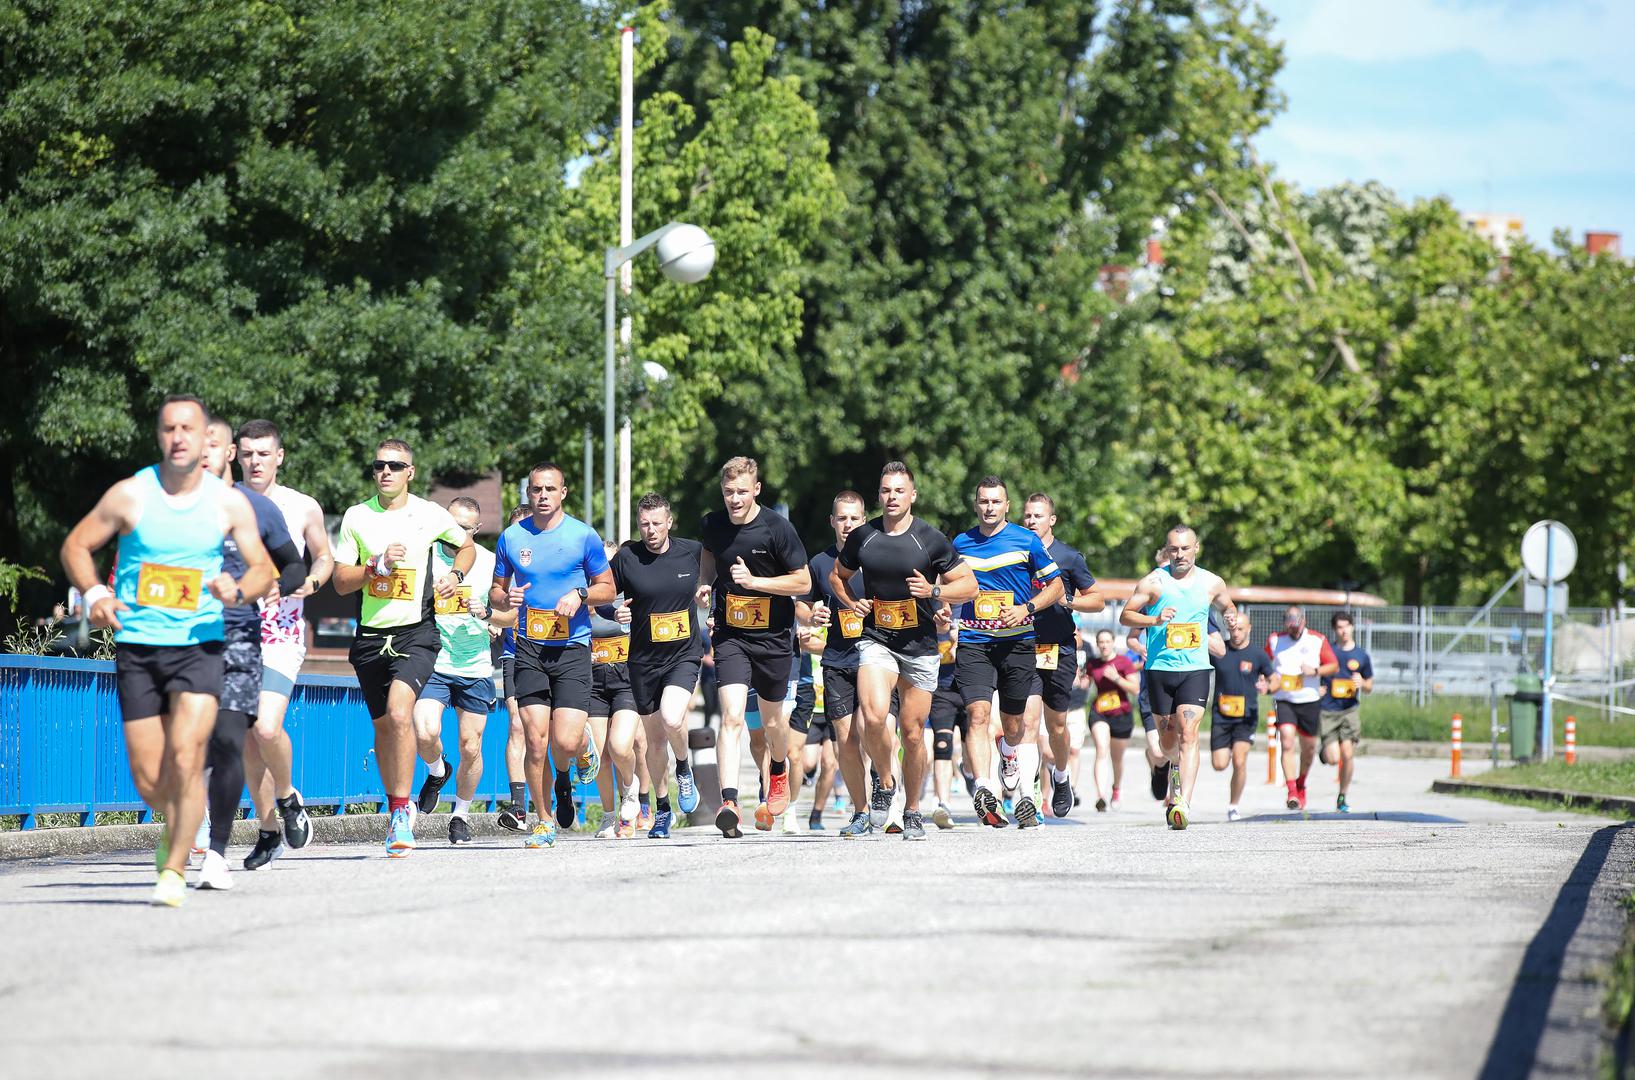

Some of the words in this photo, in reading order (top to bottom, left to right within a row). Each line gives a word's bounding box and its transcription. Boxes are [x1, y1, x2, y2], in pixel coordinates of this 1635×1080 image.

[149, 583, 164, 597] 71
[376, 582, 389, 592] 25
[436, 599, 447, 608] 37
[733, 611, 744, 620] 10
[882, 613, 892, 622] 22
[534, 623, 543, 632] 59
